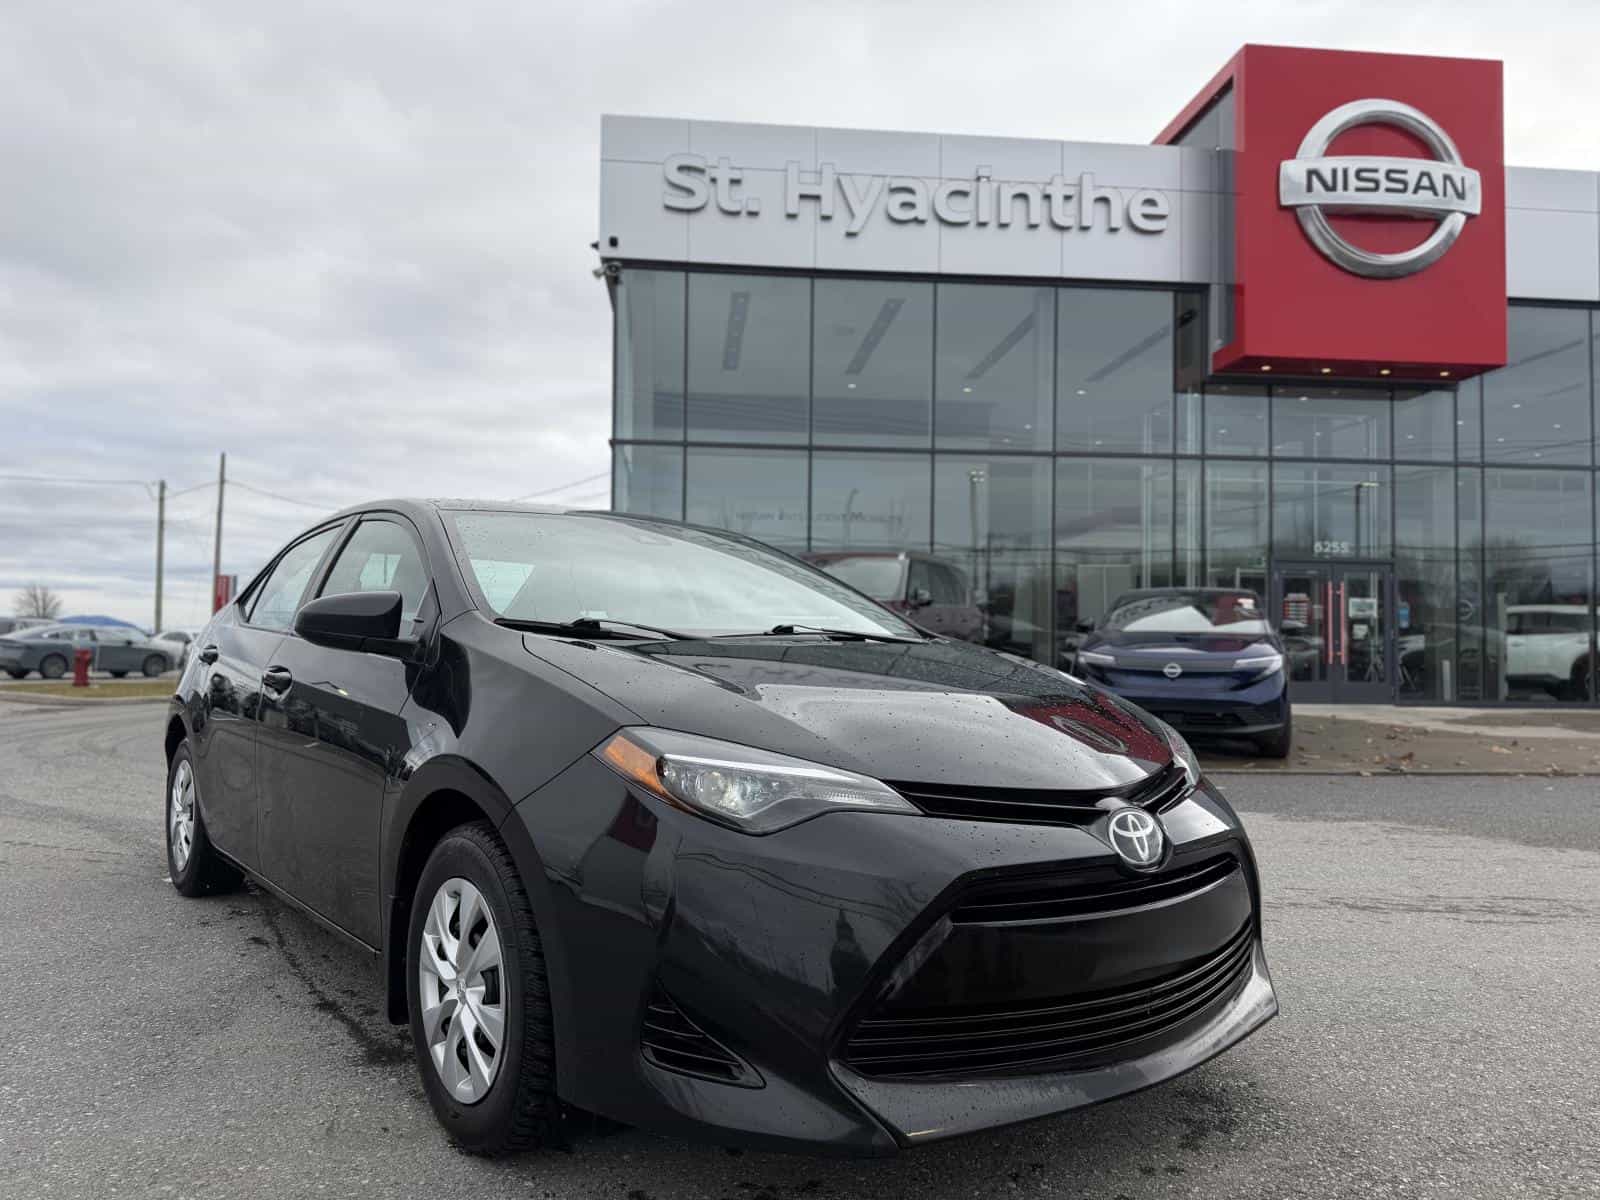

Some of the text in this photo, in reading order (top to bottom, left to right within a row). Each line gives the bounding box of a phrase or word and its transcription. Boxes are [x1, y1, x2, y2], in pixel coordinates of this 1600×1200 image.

[663, 153, 1169, 237] St. Hyacinthe
[1305, 167, 1467, 201] NISSAN
